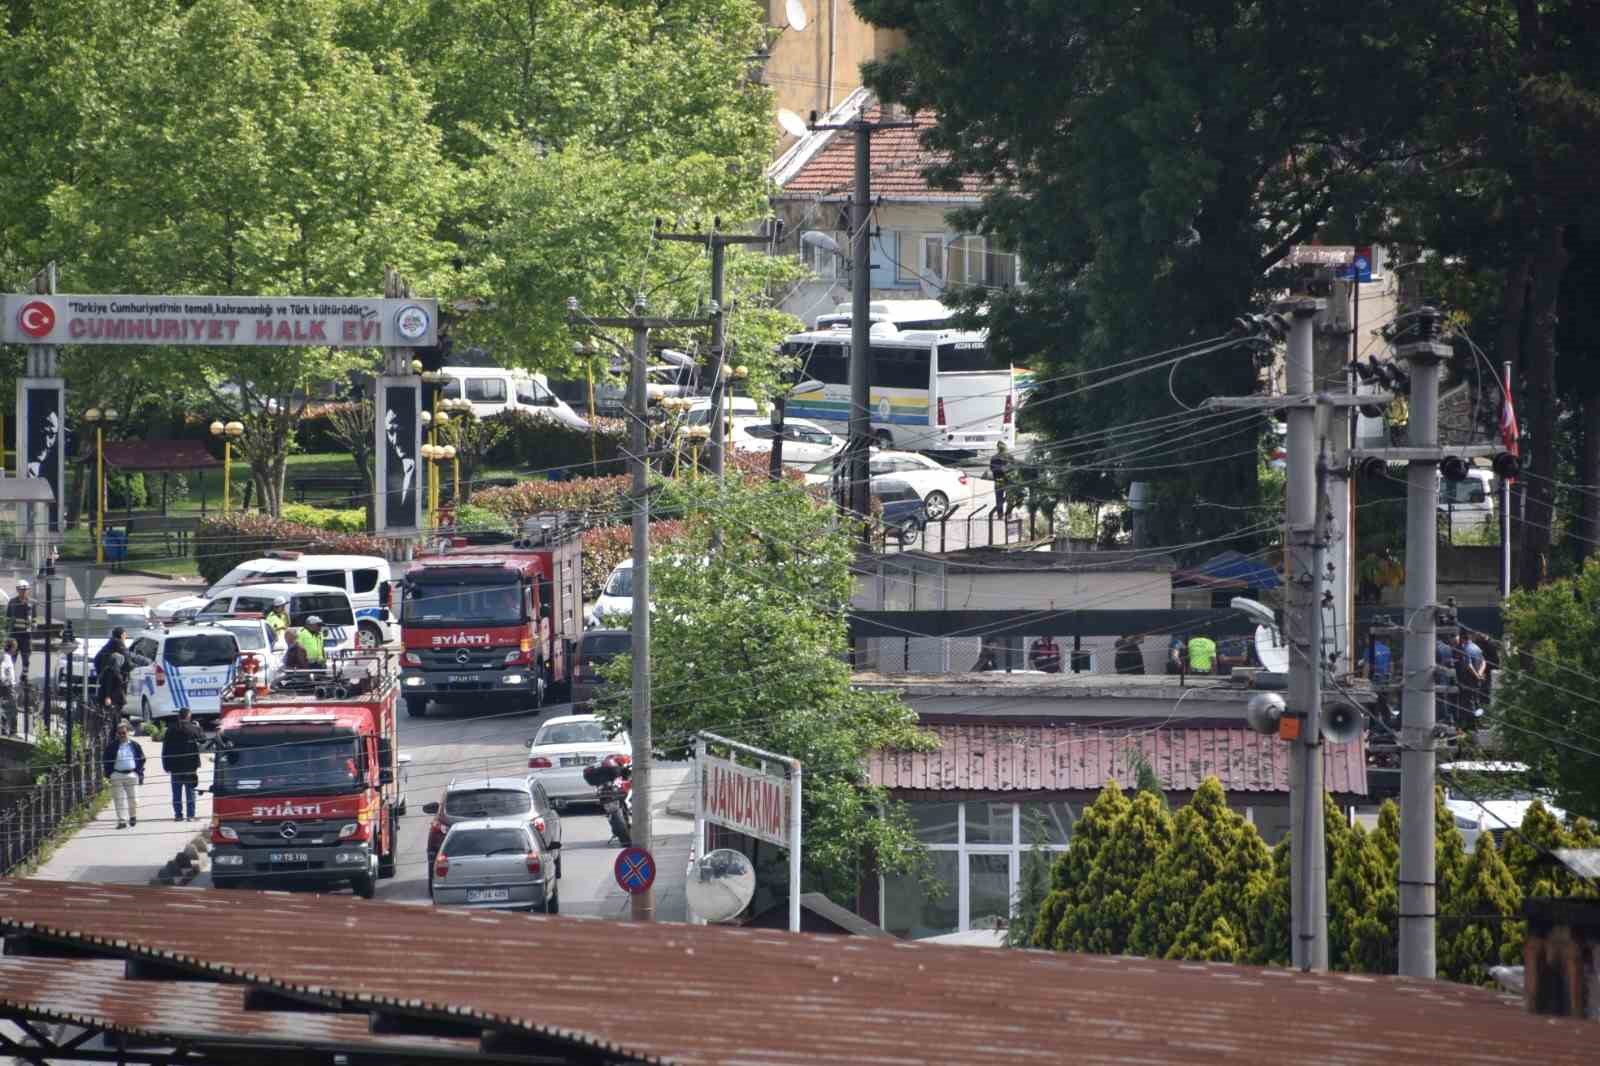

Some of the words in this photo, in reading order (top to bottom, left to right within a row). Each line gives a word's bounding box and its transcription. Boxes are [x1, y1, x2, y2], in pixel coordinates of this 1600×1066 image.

[276, 306, 287, 314] ve
[256, 319, 327, 339] HALK
[710, 765, 782, 836] JANDARMA
